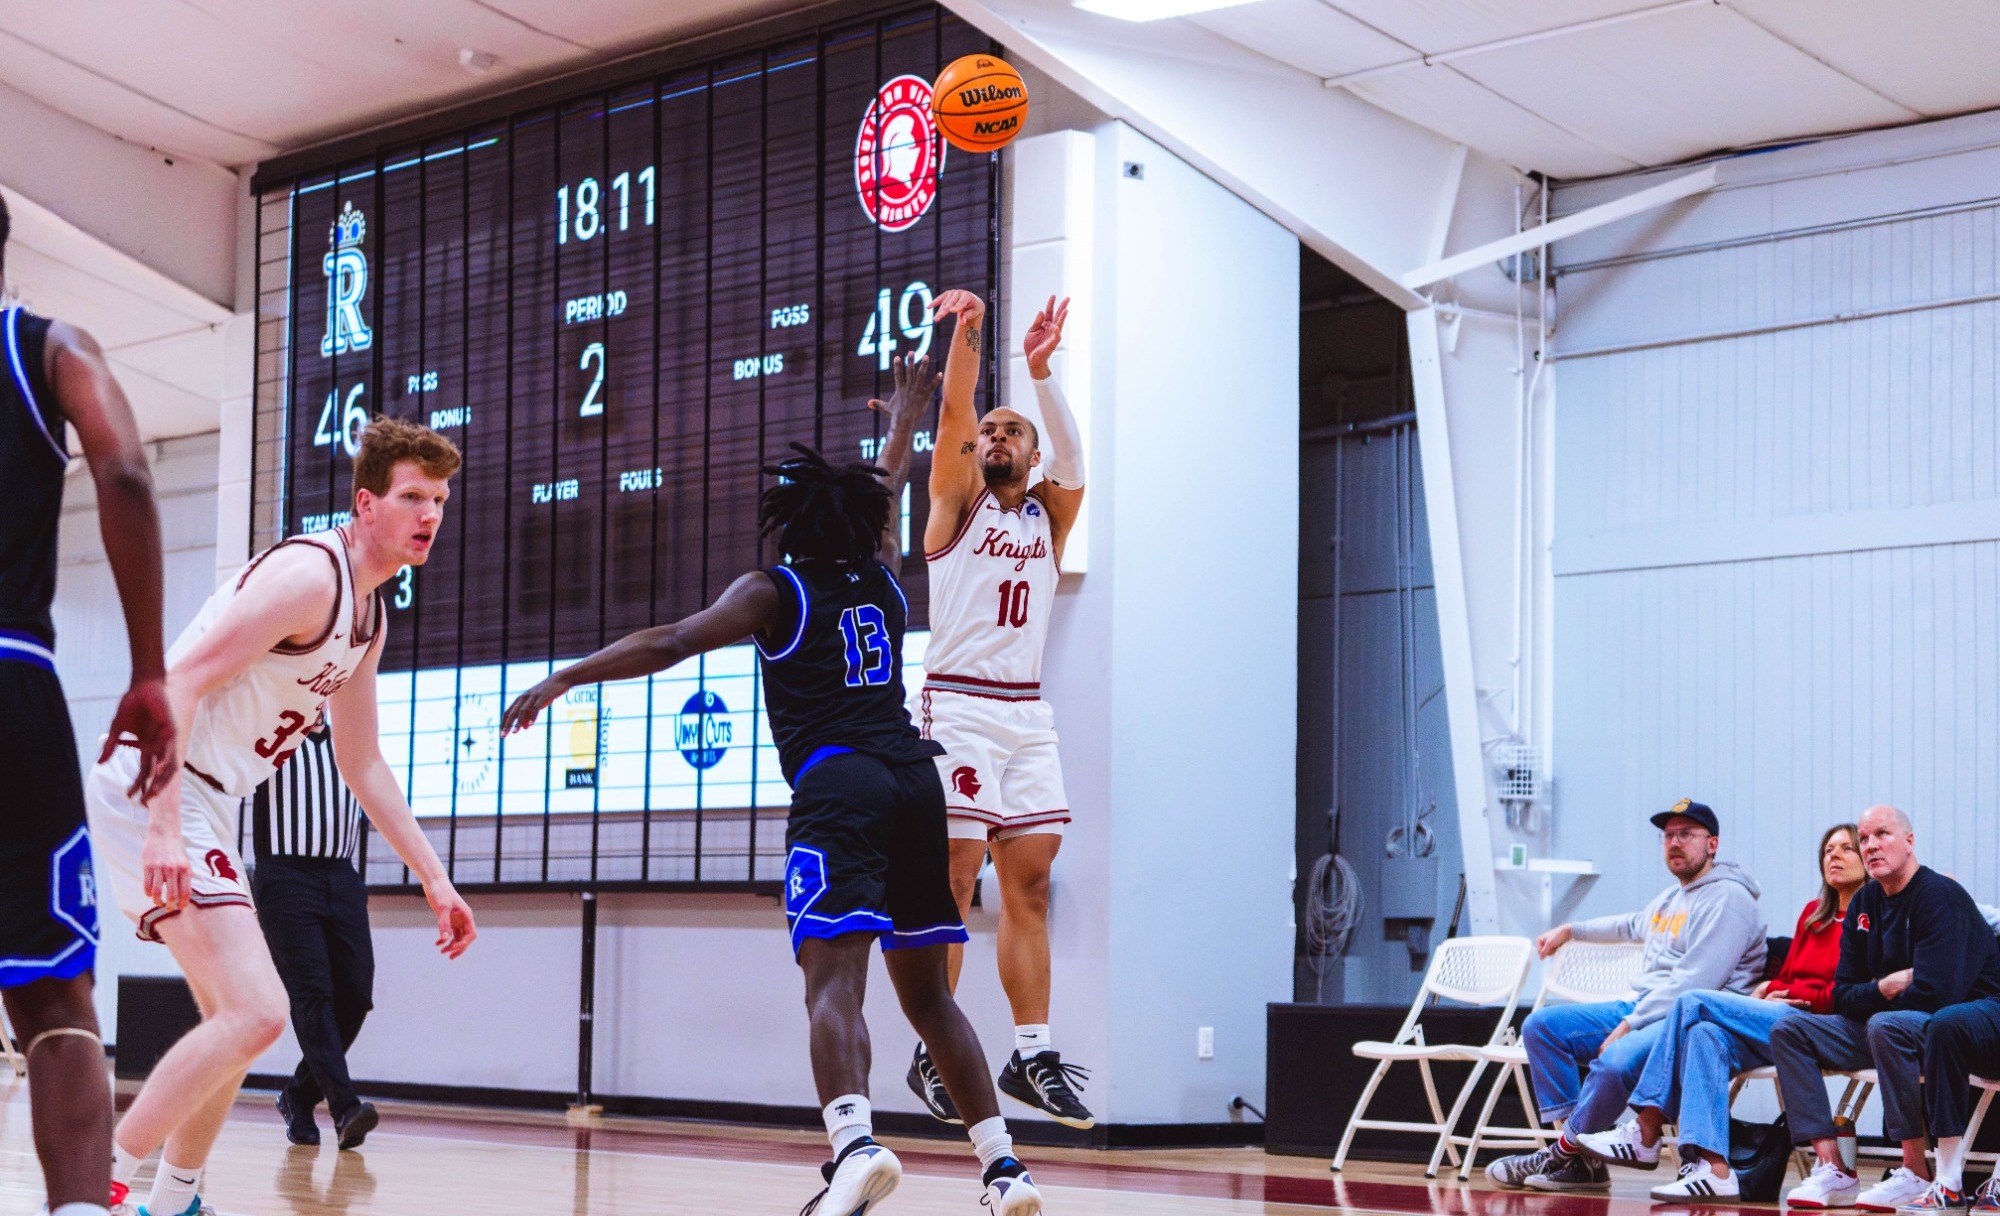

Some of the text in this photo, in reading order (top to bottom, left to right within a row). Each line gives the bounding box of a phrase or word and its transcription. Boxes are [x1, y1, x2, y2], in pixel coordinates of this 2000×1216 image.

[959, 84, 1021, 107] Wilson
[974, 115, 1018, 134] NCAA
[873, 188, 928, 223] NIGHTS
[321, 248, 372, 357] R
[565, 290, 627, 325] PERIOD
[771, 303, 810, 329] POSS
[857, 281, 935, 371] 49
[579, 342, 604, 417] 2
[733, 353, 784, 381] BONUS
[313, 383, 368, 458] 46
[532, 479, 579, 504] PLAYER
[997, 579, 1030, 628] 10
[838, 603, 893, 687] 13
[565, 689, 598, 704] Corne
[569, 773, 594, 786] BANK
[790, 875, 806, 902] R
